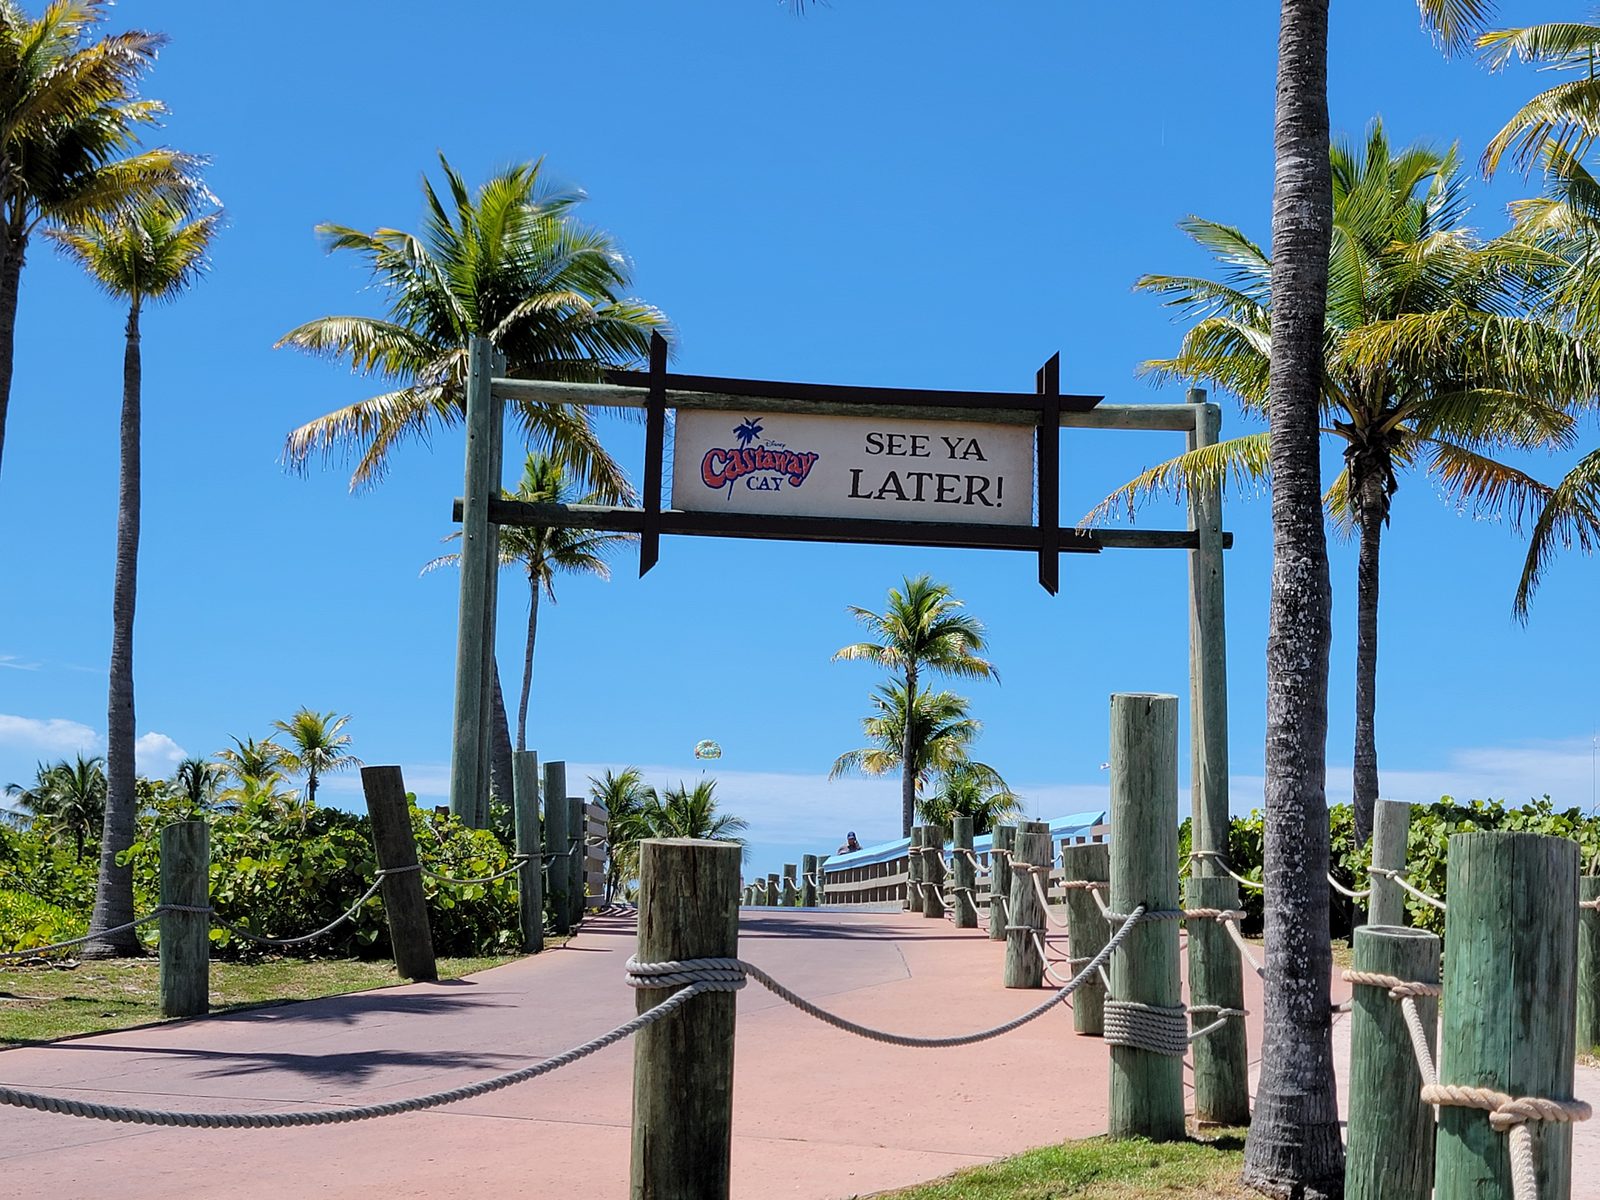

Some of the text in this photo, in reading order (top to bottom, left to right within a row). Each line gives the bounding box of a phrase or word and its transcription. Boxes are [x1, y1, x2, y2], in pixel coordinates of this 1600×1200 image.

[865, 432, 988, 462] SEE YA
[701, 445, 819, 489] Castaway
[746, 476, 784, 491] CAY
[847, 468, 1004, 507] LATER!
